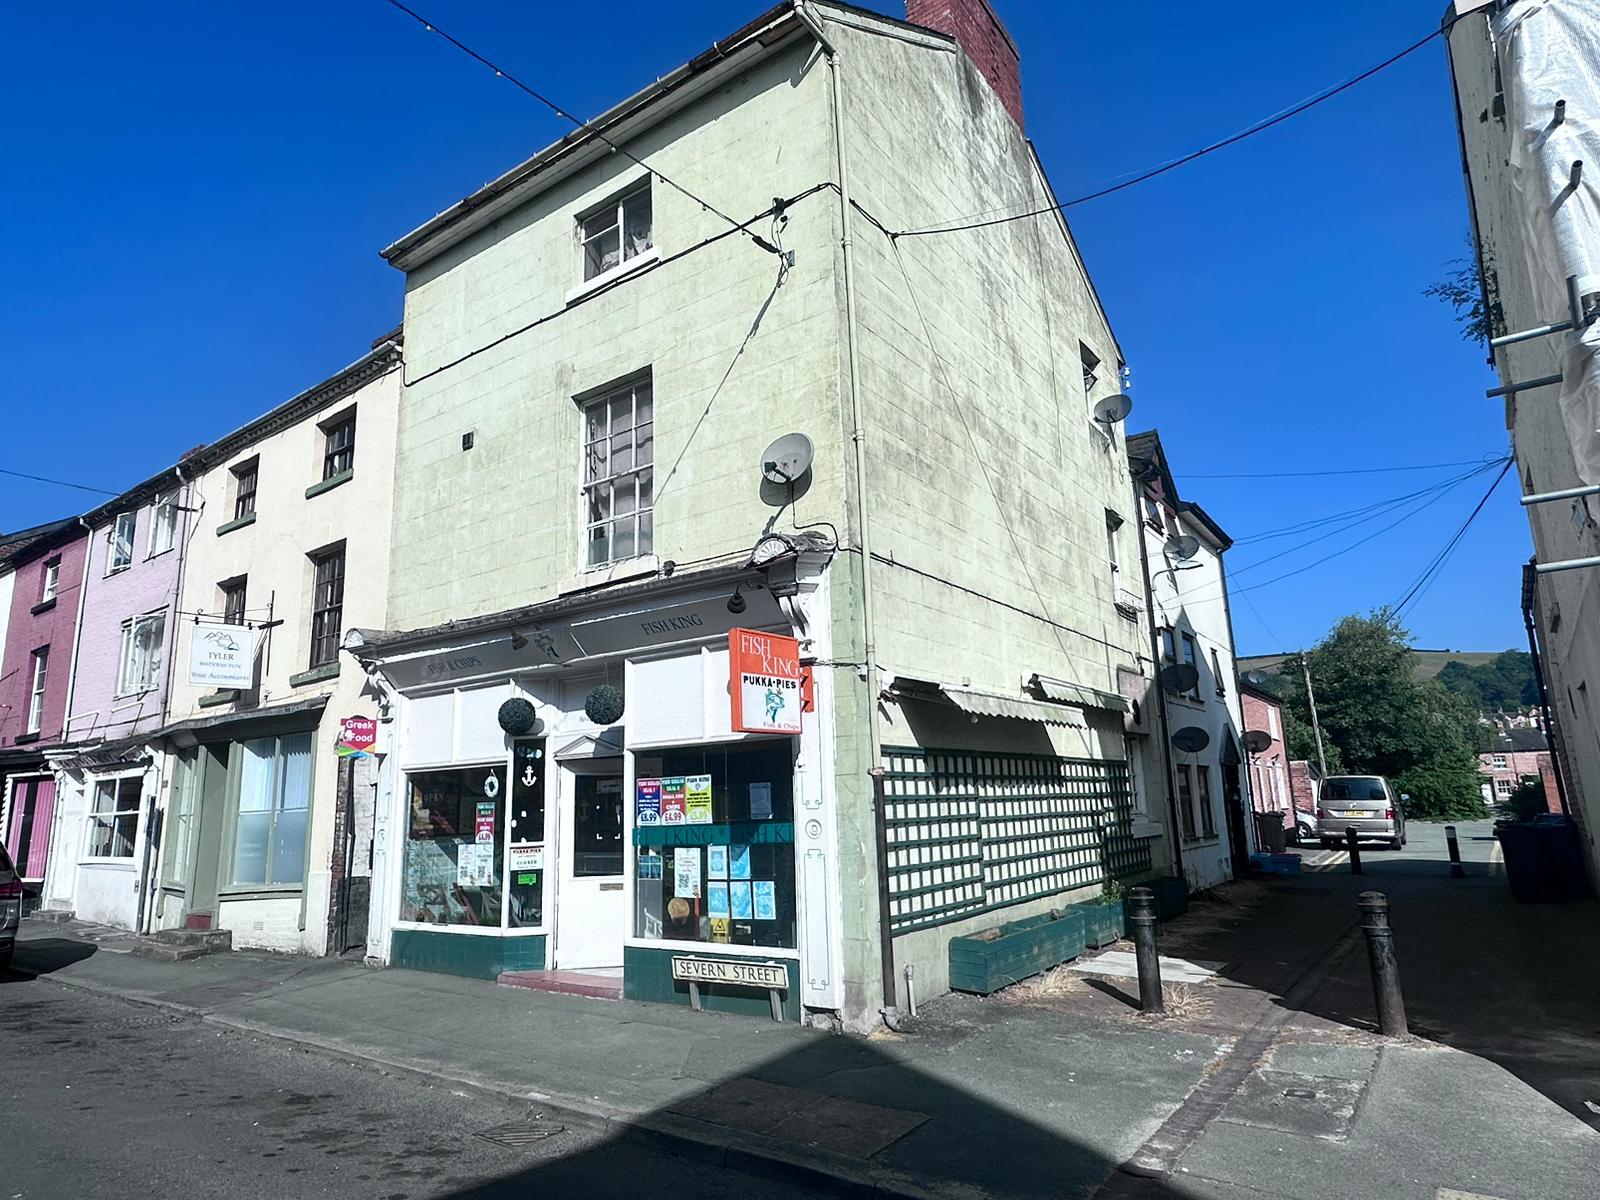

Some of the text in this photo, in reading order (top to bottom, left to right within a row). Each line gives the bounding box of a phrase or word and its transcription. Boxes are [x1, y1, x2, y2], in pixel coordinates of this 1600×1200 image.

[641, 614, 703, 635] FISH KING
[741, 634, 771, 657] FISH
[208, 652, 234, 661] TYLER
[454, 656, 482, 670] CHIPS
[762, 655, 799, 678] KING
[191, 671, 250, 681] Your Accountants
[763, 721, 776, 729] Fish
[784, 723, 800, 731] Chips
[351, 732, 374, 743] Food
[664, 812, 682, 822] £4.99
[680, 961, 779, 982] SEVERN STREET
